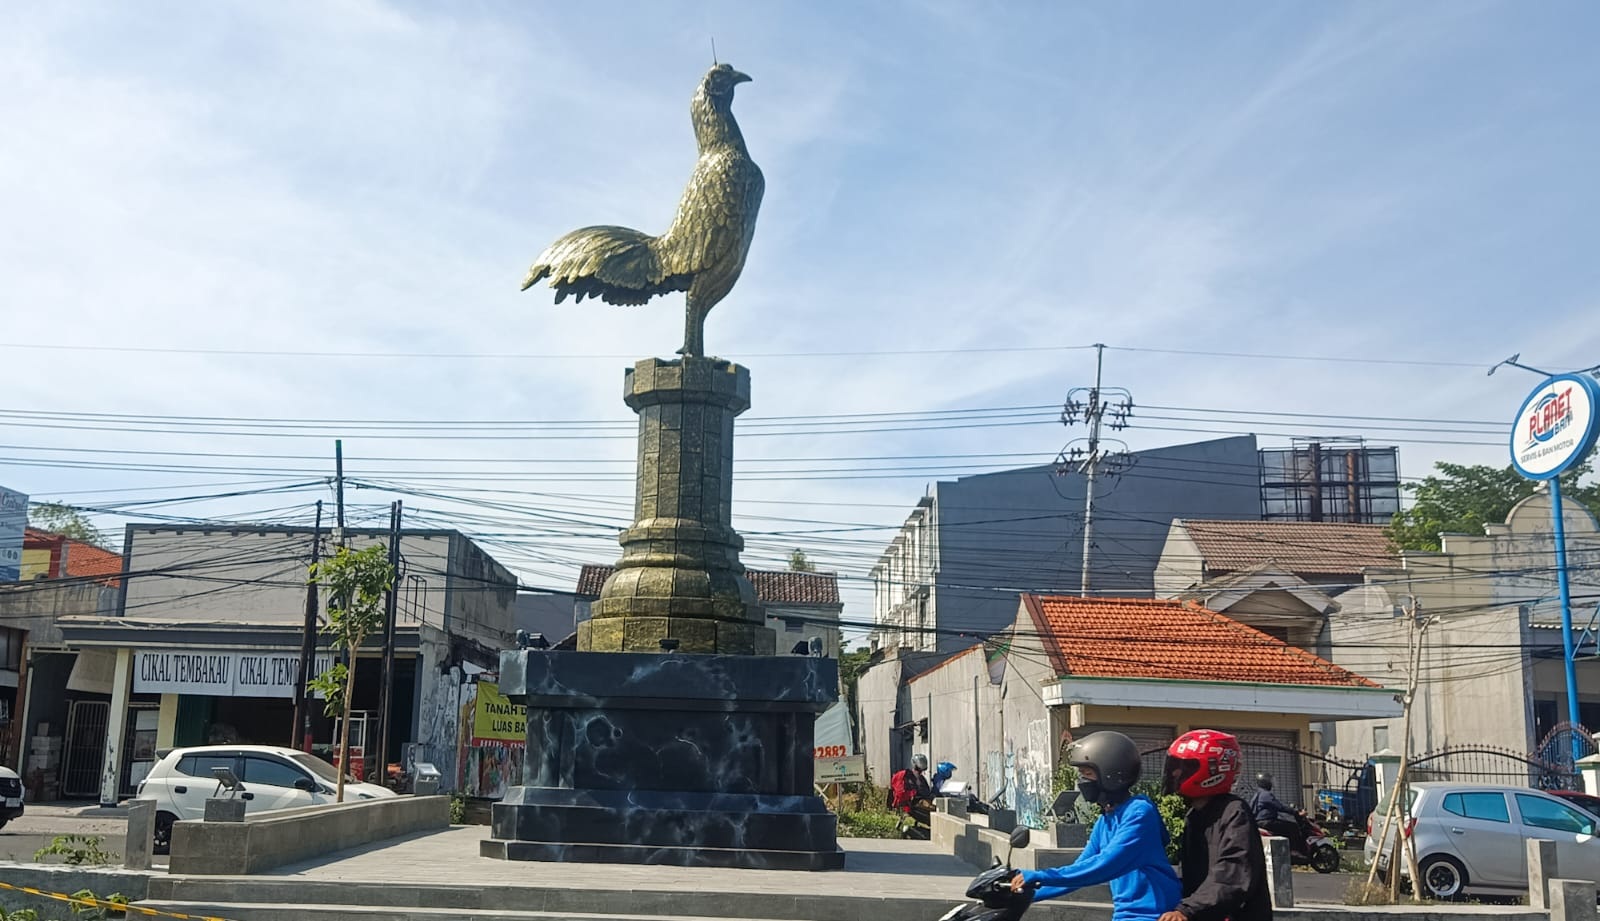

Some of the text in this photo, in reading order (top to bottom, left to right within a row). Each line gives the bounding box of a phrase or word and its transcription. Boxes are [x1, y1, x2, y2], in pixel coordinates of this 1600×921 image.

[1529, 387, 1573, 440] PLANET
[1554, 411, 1573, 434] BAN
[1520, 452, 1537, 464] SERVIS
[1542, 447, 1554, 456] BAN
[1554, 439, 1573, 452] MOTOR
[141, 653, 230, 684] CIKAL TEMBAKAU
[239, 656, 329, 686] CIKAL TEMAU
[485, 703, 517, 715] TANAH
[492, 720, 526, 733] LUAS BA
